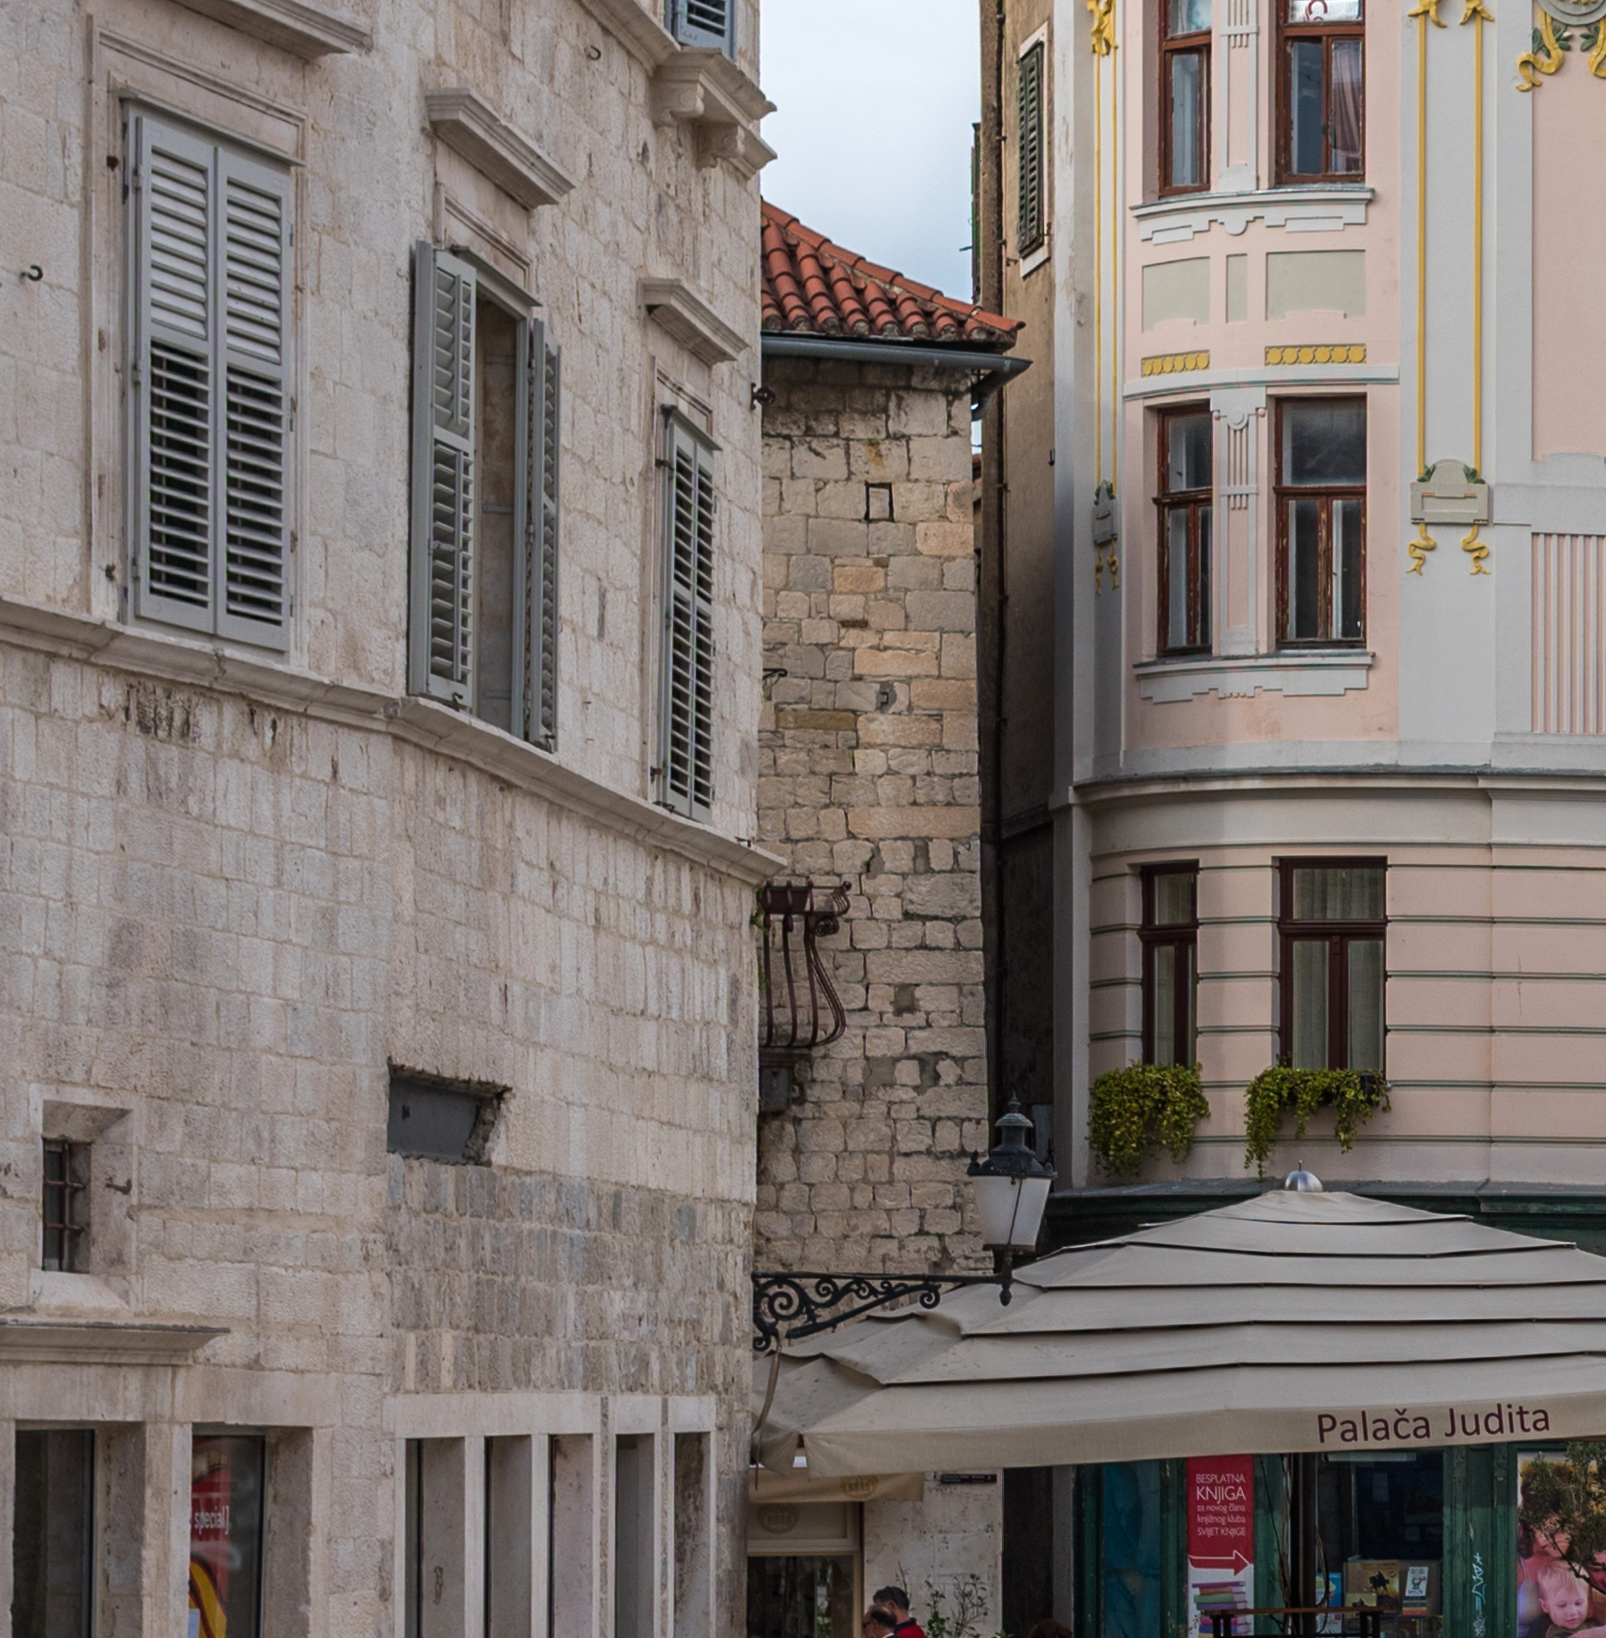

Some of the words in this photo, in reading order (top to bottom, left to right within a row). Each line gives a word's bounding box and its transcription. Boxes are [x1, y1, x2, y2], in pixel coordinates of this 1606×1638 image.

[1317, 1408, 1430, 1443] Palača
[1444, 1403, 1550, 1438] Judita
[1196, 1474, 1245, 1483] BESPLATNA
[1196, 1486, 1246, 1504] KNJIGA
